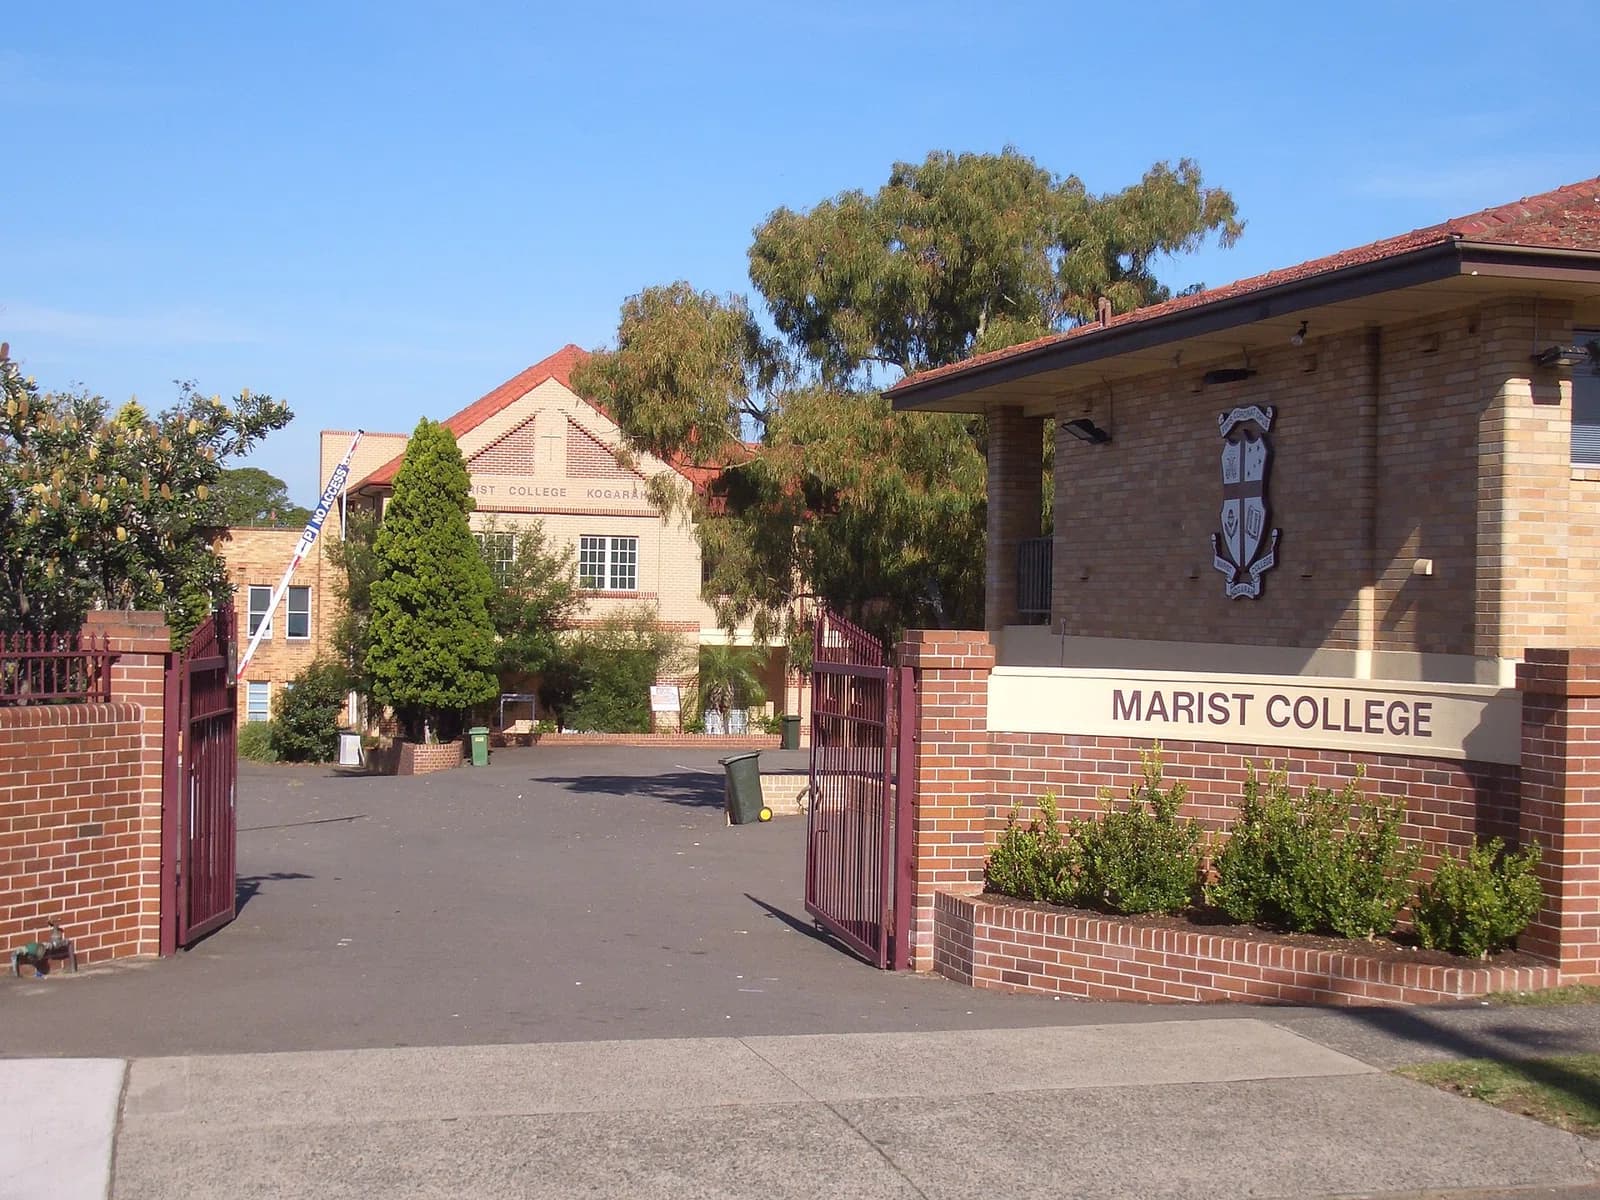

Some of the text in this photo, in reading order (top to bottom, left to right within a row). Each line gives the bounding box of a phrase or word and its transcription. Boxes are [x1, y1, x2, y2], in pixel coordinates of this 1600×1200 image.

[312, 508, 326, 525] NO
[321, 468, 347, 510] ACCESS
[468, 485, 496, 495] RIST
[508, 486, 567, 497] COLLEGE
[1112, 689, 1433, 737] MARIST COLLEGE
